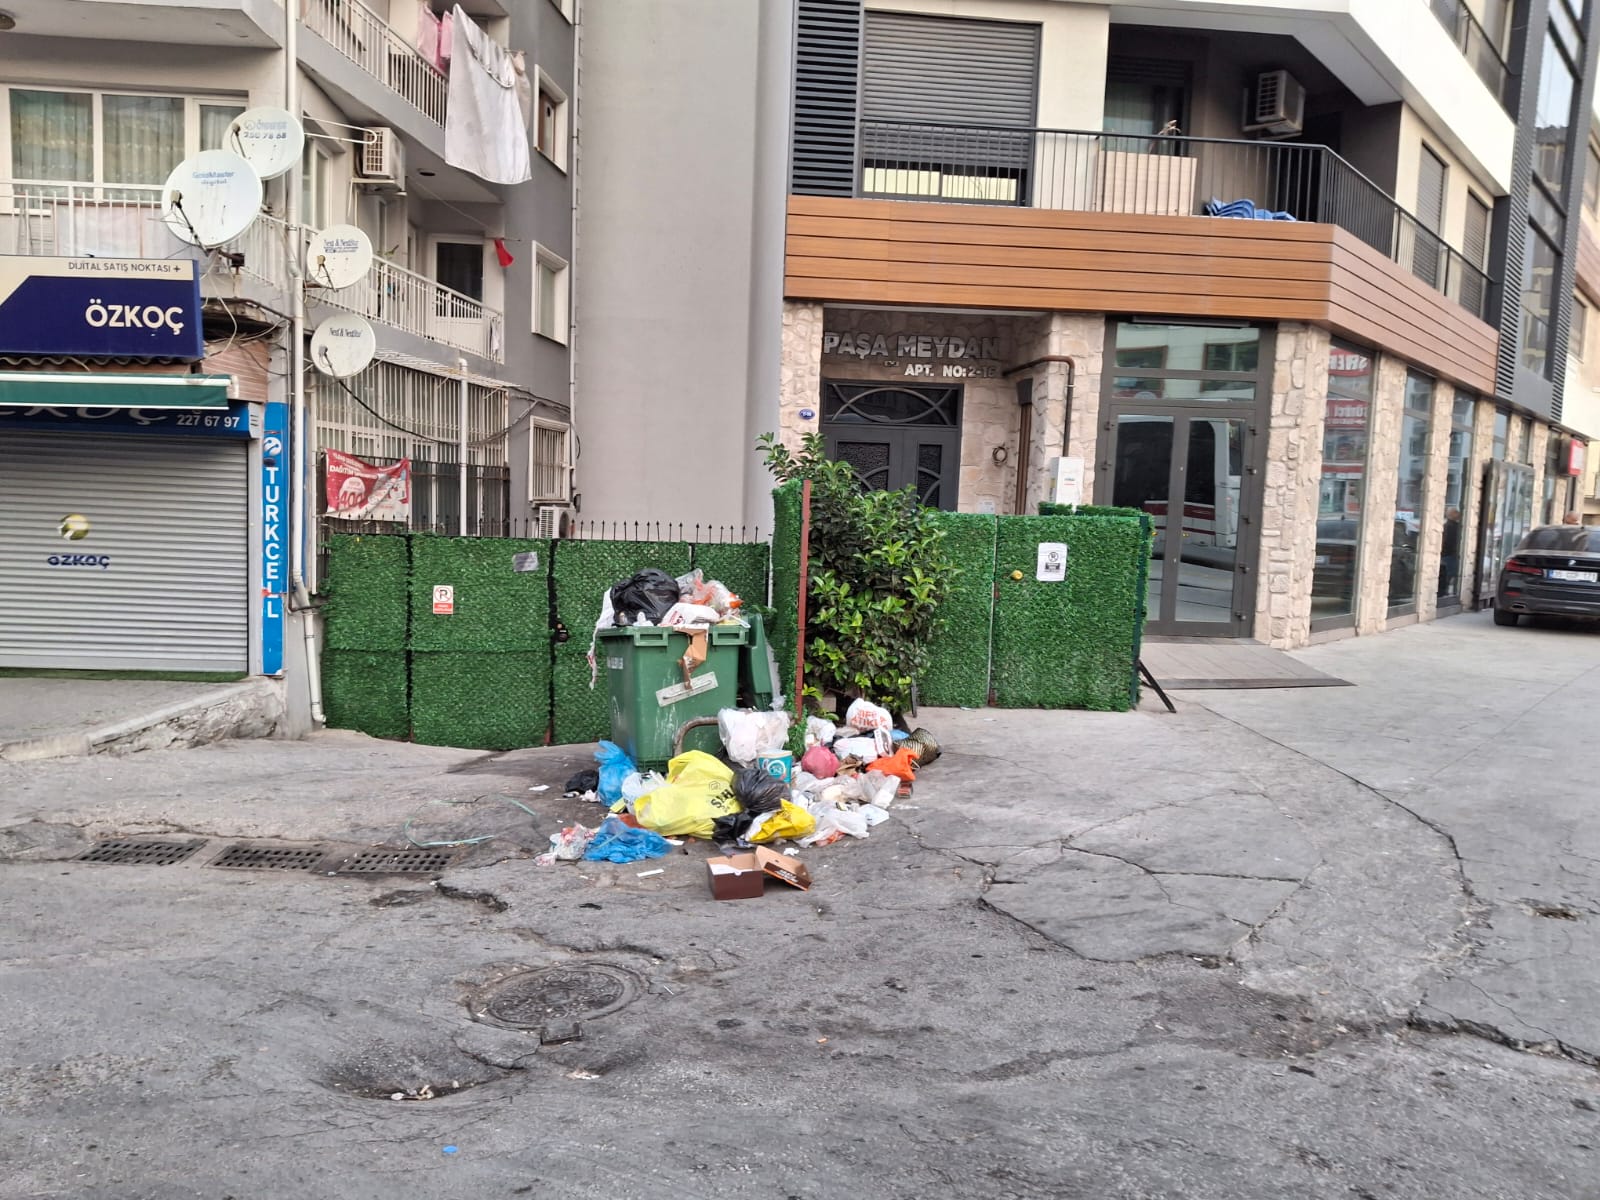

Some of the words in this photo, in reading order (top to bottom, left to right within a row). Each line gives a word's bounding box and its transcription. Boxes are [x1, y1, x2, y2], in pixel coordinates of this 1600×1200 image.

[103, 263, 128, 272] SATIŞ
[131, 264, 171, 273] NOKTASI
[85, 298, 185, 335] ÖZKOÇ
[823, 331, 889, 360] PAŞA
[904, 363, 935, 378] APT.
[176, 414, 201, 426] 227
[204, 415, 221, 427] 67
[224, 416, 240, 428] 97
[264, 466, 281, 619] TURKCELL
